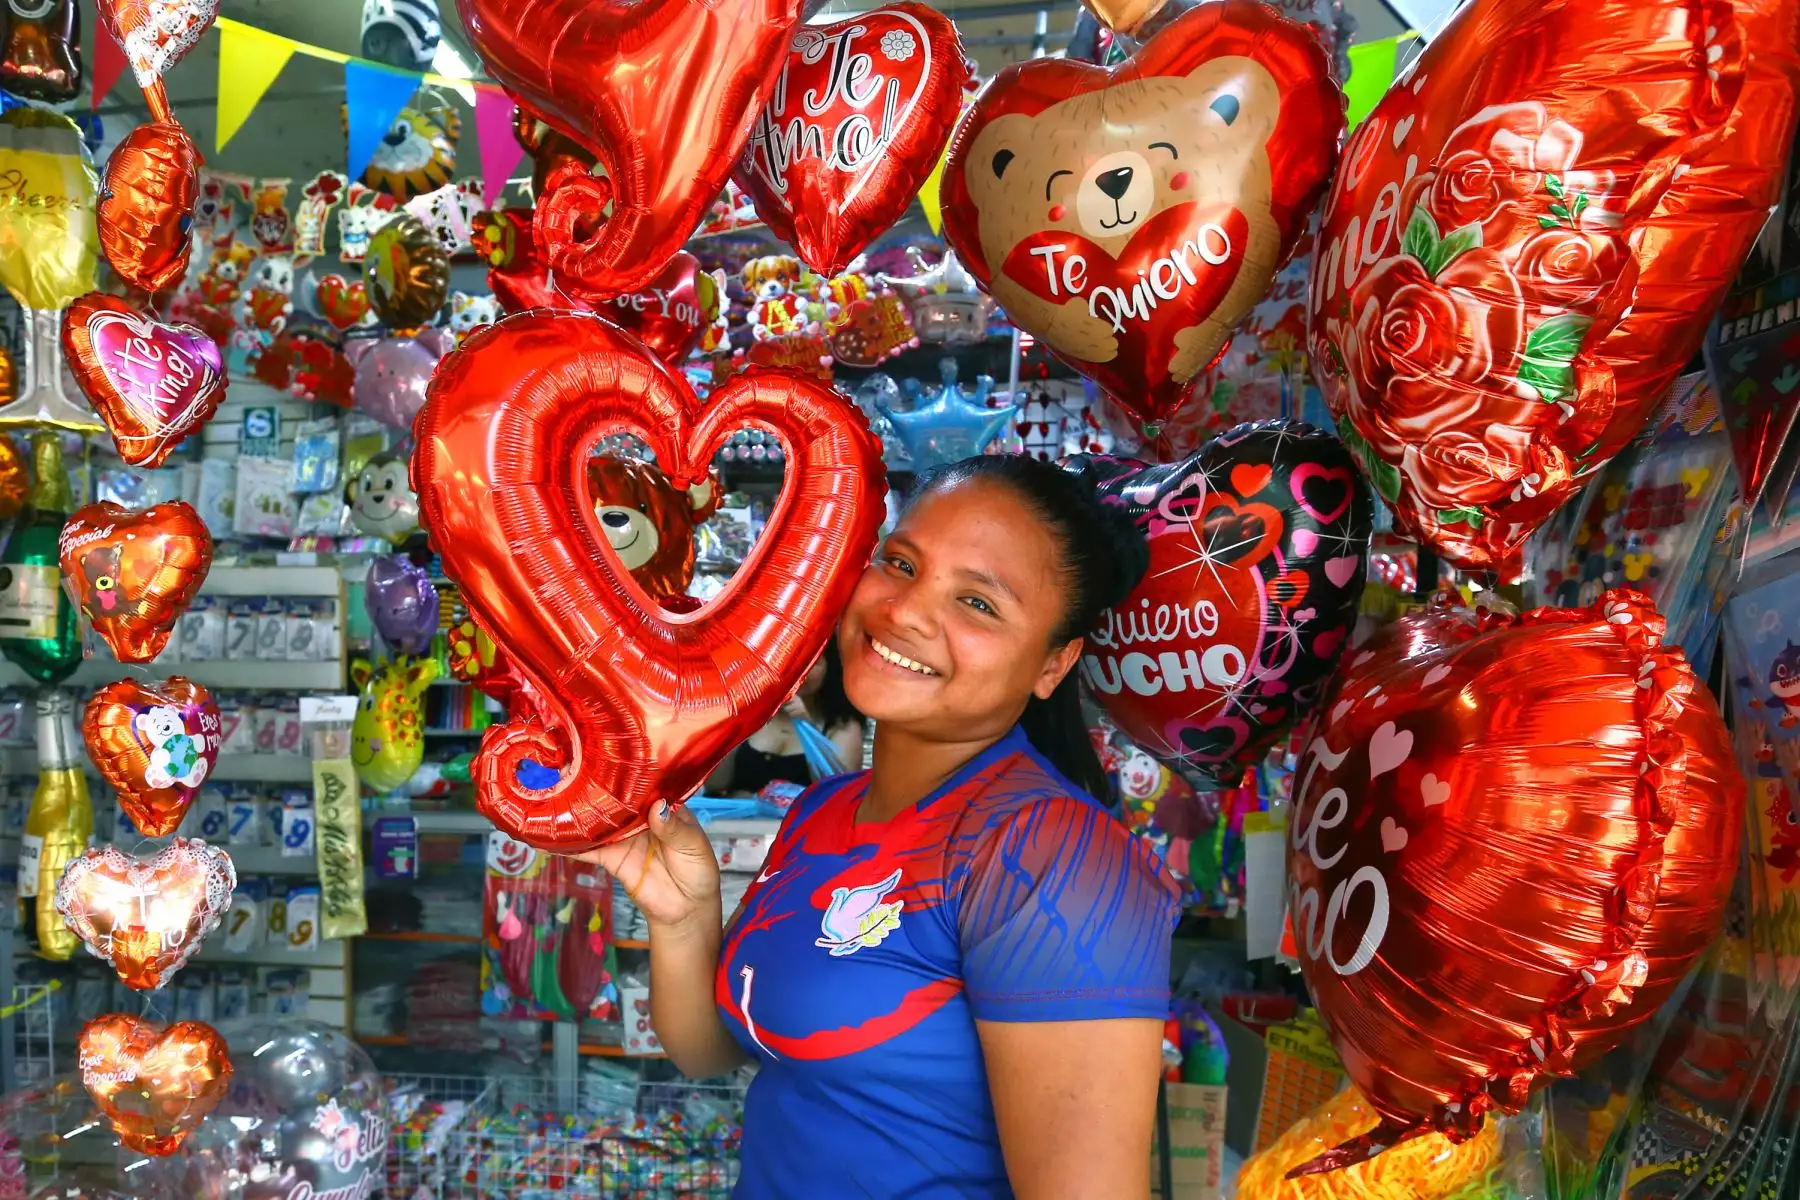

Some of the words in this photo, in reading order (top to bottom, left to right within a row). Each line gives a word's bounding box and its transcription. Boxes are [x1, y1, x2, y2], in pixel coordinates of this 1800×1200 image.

[1030, 243, 1088, 296] Te
[1088, 223, 1231, 335] Quiero
[650, 288, 700, 327] You
[1719, 297, 1800, 344] FRIEN
[138, 340, 200, 418] Amo!
[60, 523, 116, 561] Especial
[1090, 597, 1220, 650] Quiero
[1080, 643, 1247, 697] UCHO
[197, 711, 219, 733] Eres
[229, 806, 253, 836] 7
[1292, 736, 1352, 870] Te
[285, 818, 310, 848] 9
[229, 909, 251, 936] 7
[288, 919, 313, 946] 9
[1288, 865, 1390, 976] mo
[83, 1066, 138, 1088] Especial
[334, 1110, 387, 1173] Feliz
